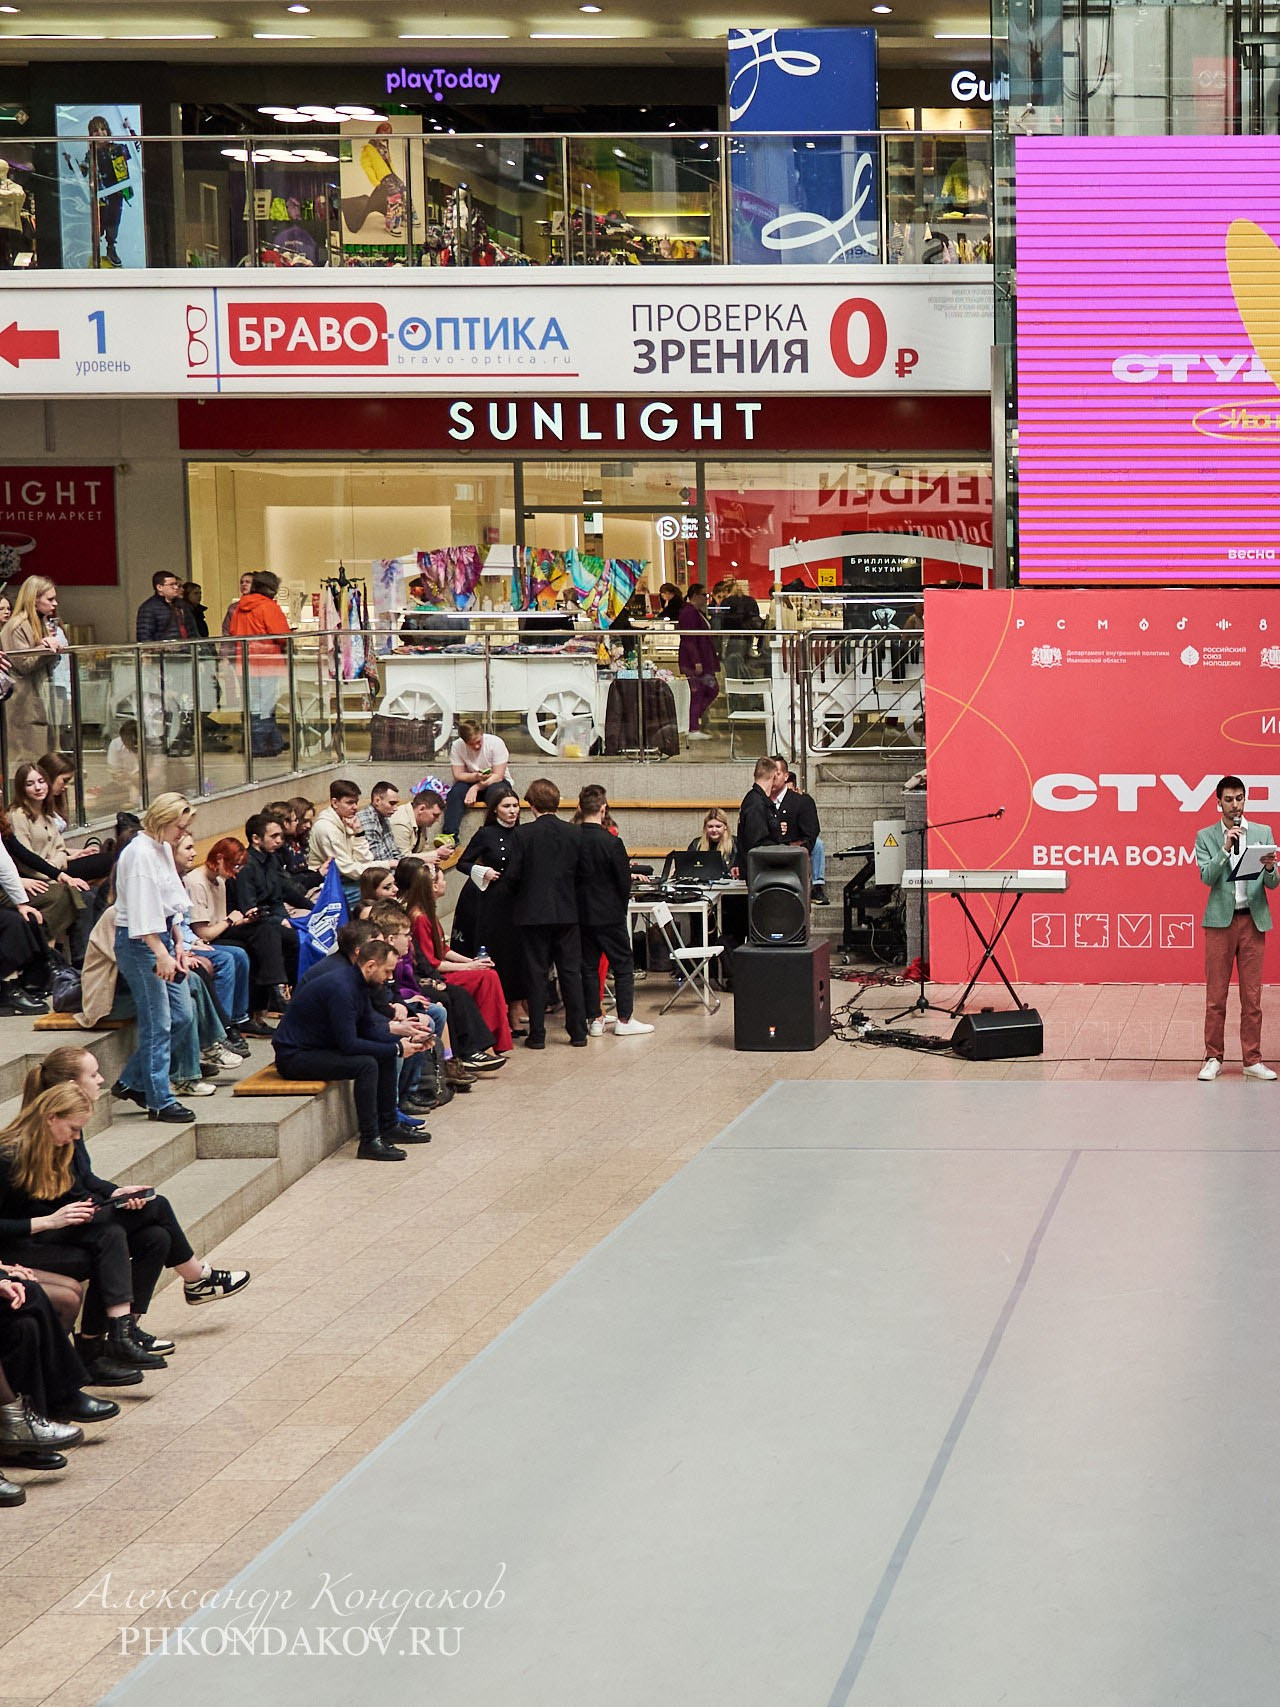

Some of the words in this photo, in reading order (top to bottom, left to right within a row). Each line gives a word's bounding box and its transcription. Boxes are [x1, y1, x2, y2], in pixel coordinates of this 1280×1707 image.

[386, 67, 501, 94] playToday
[632, 304, 807, 332] ПРОВЕРКА
[88, 311, 106, 354] 1
[75, 361, 131, 375] уровень
[633, 339, 809, 374] ЗРЕНИЯ
[447, 400, 762, 442] SUNLIGHT
[5, 480, 102, 506] IGHT
[1228, 548, 1275, 560] весна
[1033, 845, 1118, 867] ВЕСНА
